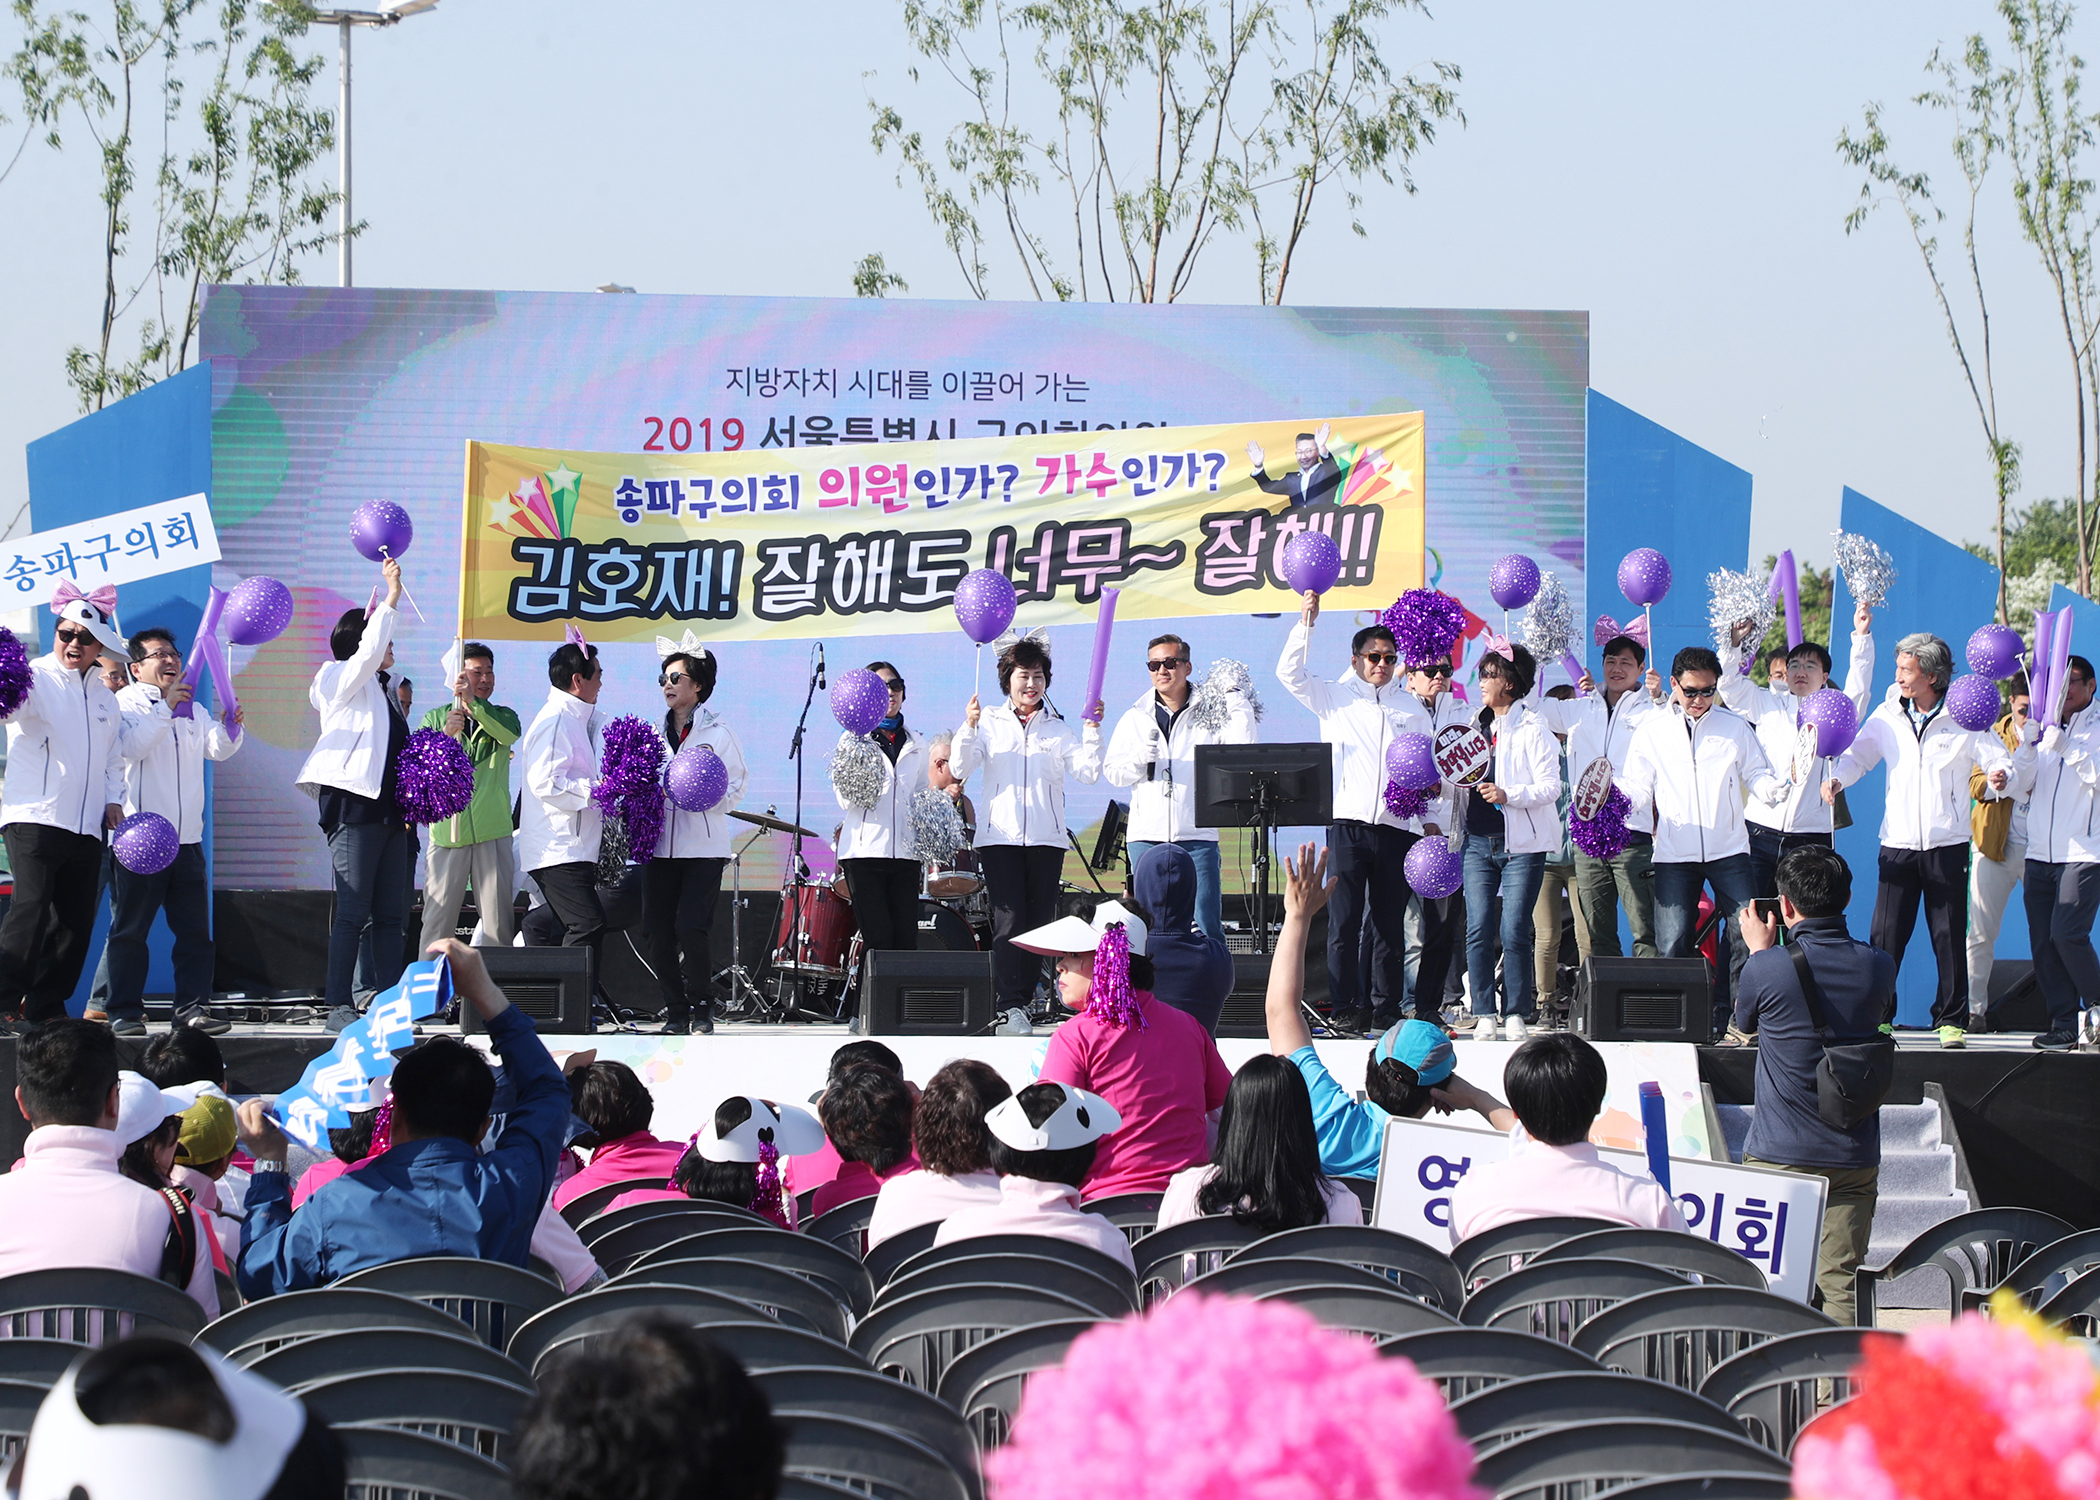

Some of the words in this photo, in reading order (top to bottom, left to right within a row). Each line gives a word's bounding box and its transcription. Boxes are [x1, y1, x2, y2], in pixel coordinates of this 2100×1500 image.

[724, 367, 839, 399] 지방자치
[847, 369, 933, 401] 시대를
[942, 370, 1024, 402] 이끌어
[1034, 372, 1091, 403] 가는
[643, 416, 745, 451] 2019
[615, 473, 800, 523] 송파구의회
[818, 463, 1020, 513] 의원인가?
[1035, 451, 1227, 498] 가수인가?
[3, 511, 200, 592] 송파구의회
[512, 541, 740, 617] 김호재!
[758, 535, 968, 614] 잘해도
